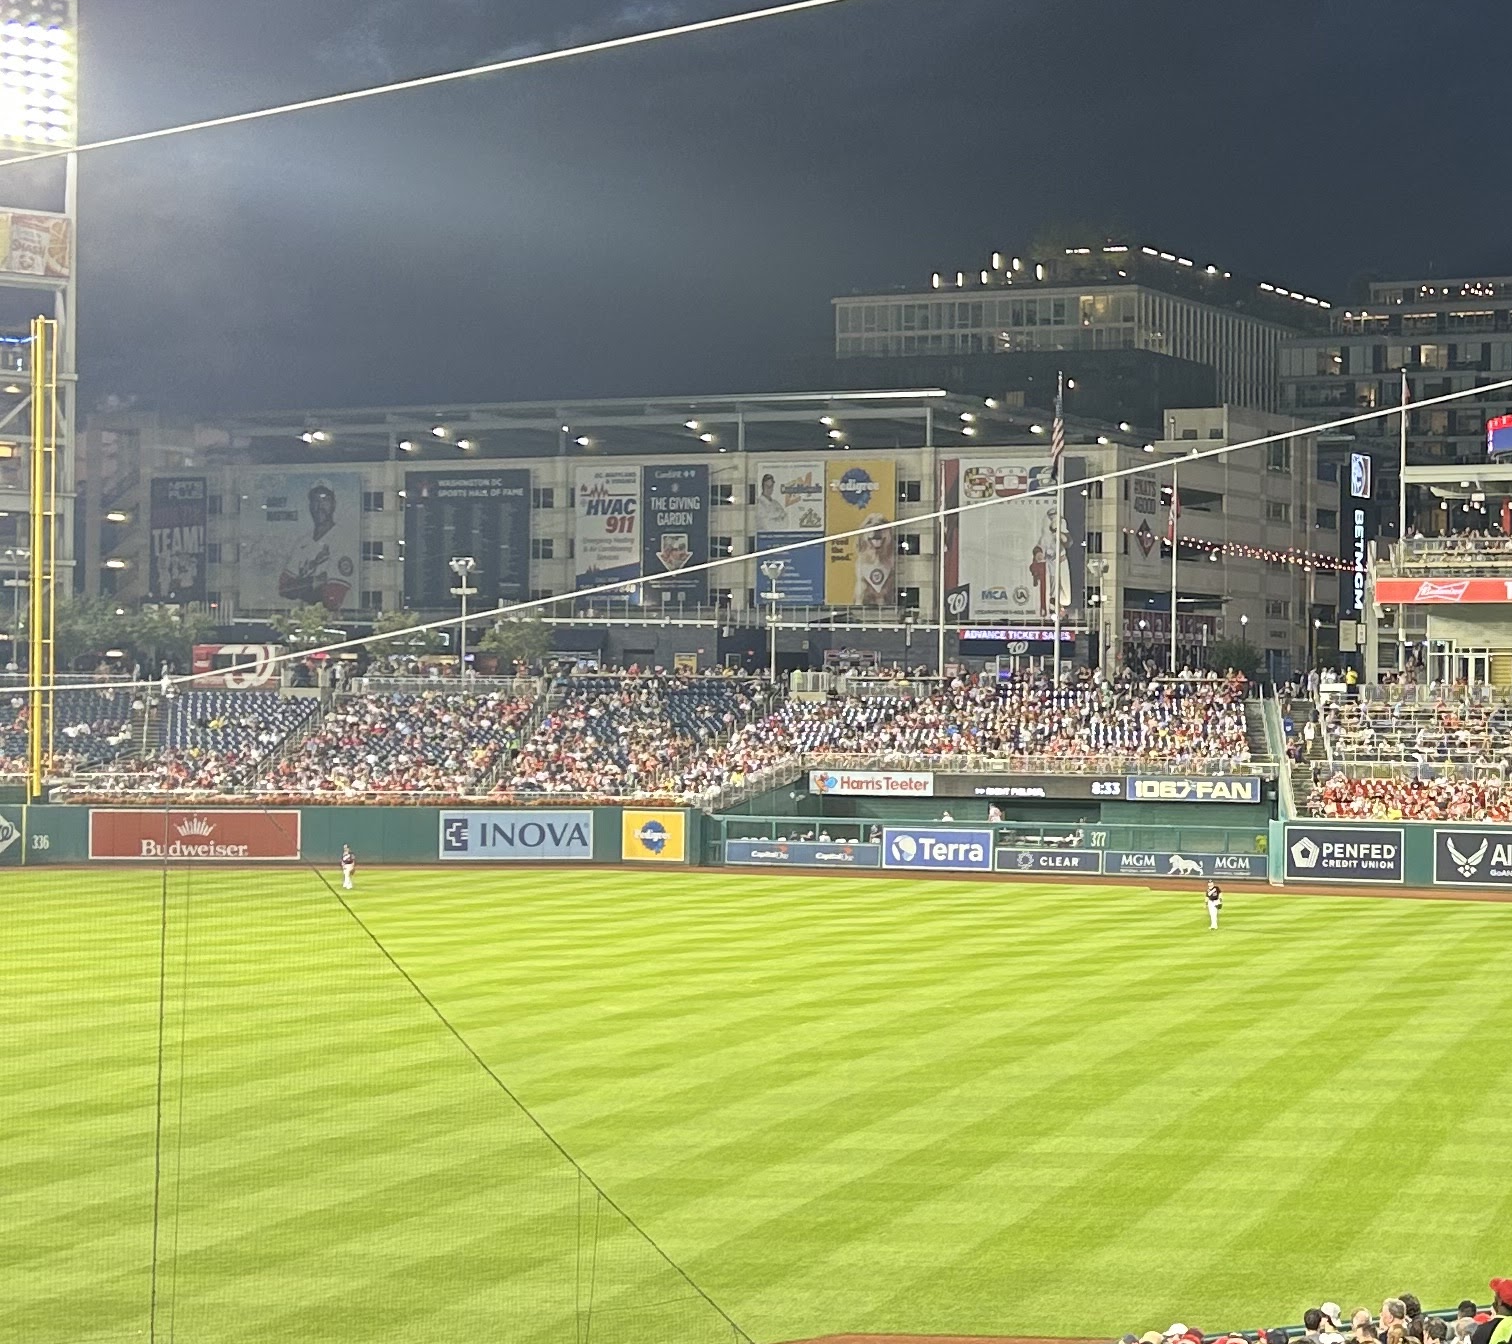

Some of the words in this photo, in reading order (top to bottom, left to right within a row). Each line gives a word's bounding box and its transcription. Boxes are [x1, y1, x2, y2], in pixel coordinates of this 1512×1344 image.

[586, 498, 636, 516] HVAC
[651, 496, 668, 510] THE
[669, 496, 700, 510] GIVING
[605, 516, 634, 534] 911
[657, 512, 693, 525] GARDEN
[1354, 509, 1365, 610] BETMGM
[964, 630, 1006, 640] ADVANCE
[1008, 631, 1040, 640] TICKET
[840, 775, 882, 792] Harris
[883, 775, 930, 793] Teeter
[1091, 781, 1122, 795] 8:33
[1195, 781, 1252, 800] FAN
[32, 834, 49, 850] 336
[480, 822, 588, 848] INOVA
[1091, 831, 1106, 847] 377
[140, 839, 249, 857] Budweiser
[919, 836, 984, 863] Terra
[1322, 843, 1396, 859] PENFED
[1040, 856, 1081, 867] CLEAR
[1120, 854, 1156, 867] MGM
[1214, 856, 1250, 869] MGM
[1322, 860, 1357, 869] CREDIT
[1361, 860, 1394, 870] UNION
